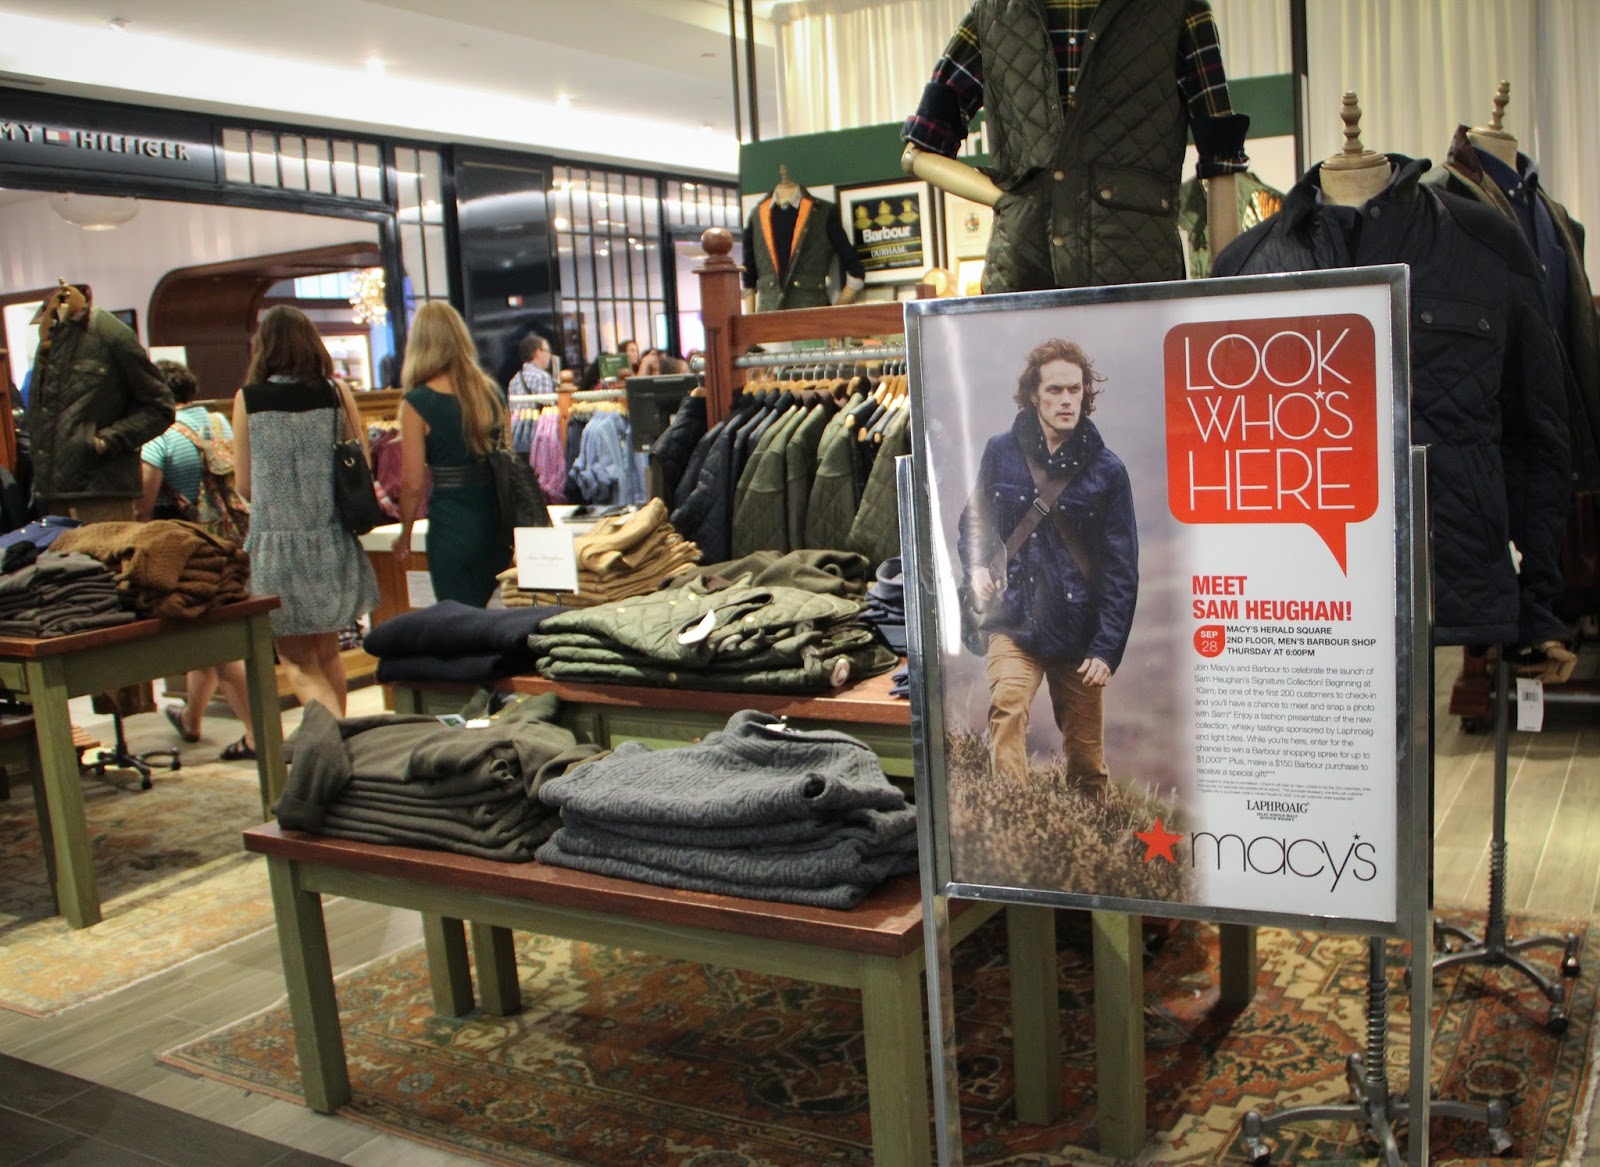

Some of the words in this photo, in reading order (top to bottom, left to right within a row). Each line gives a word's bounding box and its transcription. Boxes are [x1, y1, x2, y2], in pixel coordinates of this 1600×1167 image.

[76, 130, 191, 160] HILFIGER
[862, 225, 912, 243] Barbour
[1185, 328, 1352, 391] LOOK
[1186, 388, 1354, 443] WHO'S
[1188, 447, 1355, 511] HERE
[1192, 575, 1248, 596] MEET
[1192, 599, 1239, 620] SAM
[1245, 600, 1352, 622] HEUGHAN!
[1200, 630, 1218, 638] SEP
[1226, 625, 1259, 634] MACY'S
[1260, 626, 1294, 634] HERALD
[1296, 627, 1332, 635] SQUARE
[1201, 640, 1218, 652] 28
[1226, 636, 1244, 644] 2ND
[1245, 637, 1276, 646] FLOOR,
[1278, 637, 1305, 645] MEN'S
[1307, 638, 1350, 646] BARBOUR
[1351, 639, 1377, 647] SHOP
[1226, 647, 1271, 656] THURSDAY
[1273, 648, 1284, 656] AT
[1285, 648, 1315, 657] 6:00PM
[1210, 664, 1235, 673] Macy's
[1251, 665, 1281, 673] Barbour
[1291, 666, 1325, 674] celebrate
[1340, 667, 1364, 675] launch
[1366, 667, 1374, 675] of
[1194, 674, 1211, 682] Sam
[1212, 675, 1250, 685] Heughan's
[1251, 676, 1285, 685] Signature
[1325, 679, 1362, 688] Beginning
[1195, 687, 1216, 695] 10am,
[1252, 688, 1264, 696] the
[1280, 689, 1295, 697] 200
[1296, 691, 1334, 699] customers
[1336, 691, 1343, 699] to
[1345, 691, 1377, 699] check-in
[1290, 702, 1309, 710] meet
[1326, 704, 1344, 712] snap
[1353, 704, 1375, 712] photo
[1233, 711, 1253, 720] Enjoy
[1260, 712, 1286, 720] fashion
[1287, 714, 1332, 722] presentation
[1342, 715, 1354, 723] the
[1195, 722, 1229, 731] collection,
[1231, 723, 1255, 732] whisky
[1257, 724, 1284, 734] tastings
[1285, 726, 1324, 734] sponsored
[1326, 727, 1335, 735] by
[1336, 727, 1374, 737] Laphroaig
[1210, 734, 1225, 742] light
[1246, 735, 1266, 743] While
[1267, 736, 1289, 744] you're
[1290, 738, 1308, 746] here,
[1341, 739, 1353, 747] the
[1195, 745, 1222, 753] chance
[1251, 746, 1281, 755] Barbour
[1282, 749, 1316, 758] shopping
[1340, 750, 1350, 759] for
[1351, 752, 1361, 760] up
[1228, 757, 1246, 765] Plus,
[1247, 758, 1267, 766] make
[1274, 759, 1293, 767] $150
[1294, 760, 1323, 769] Barbour
[1325, 762, 1359, 771] purchase
[1228, 769, 1253, 777] special
[1191, 832, 1377, 893] macy's
